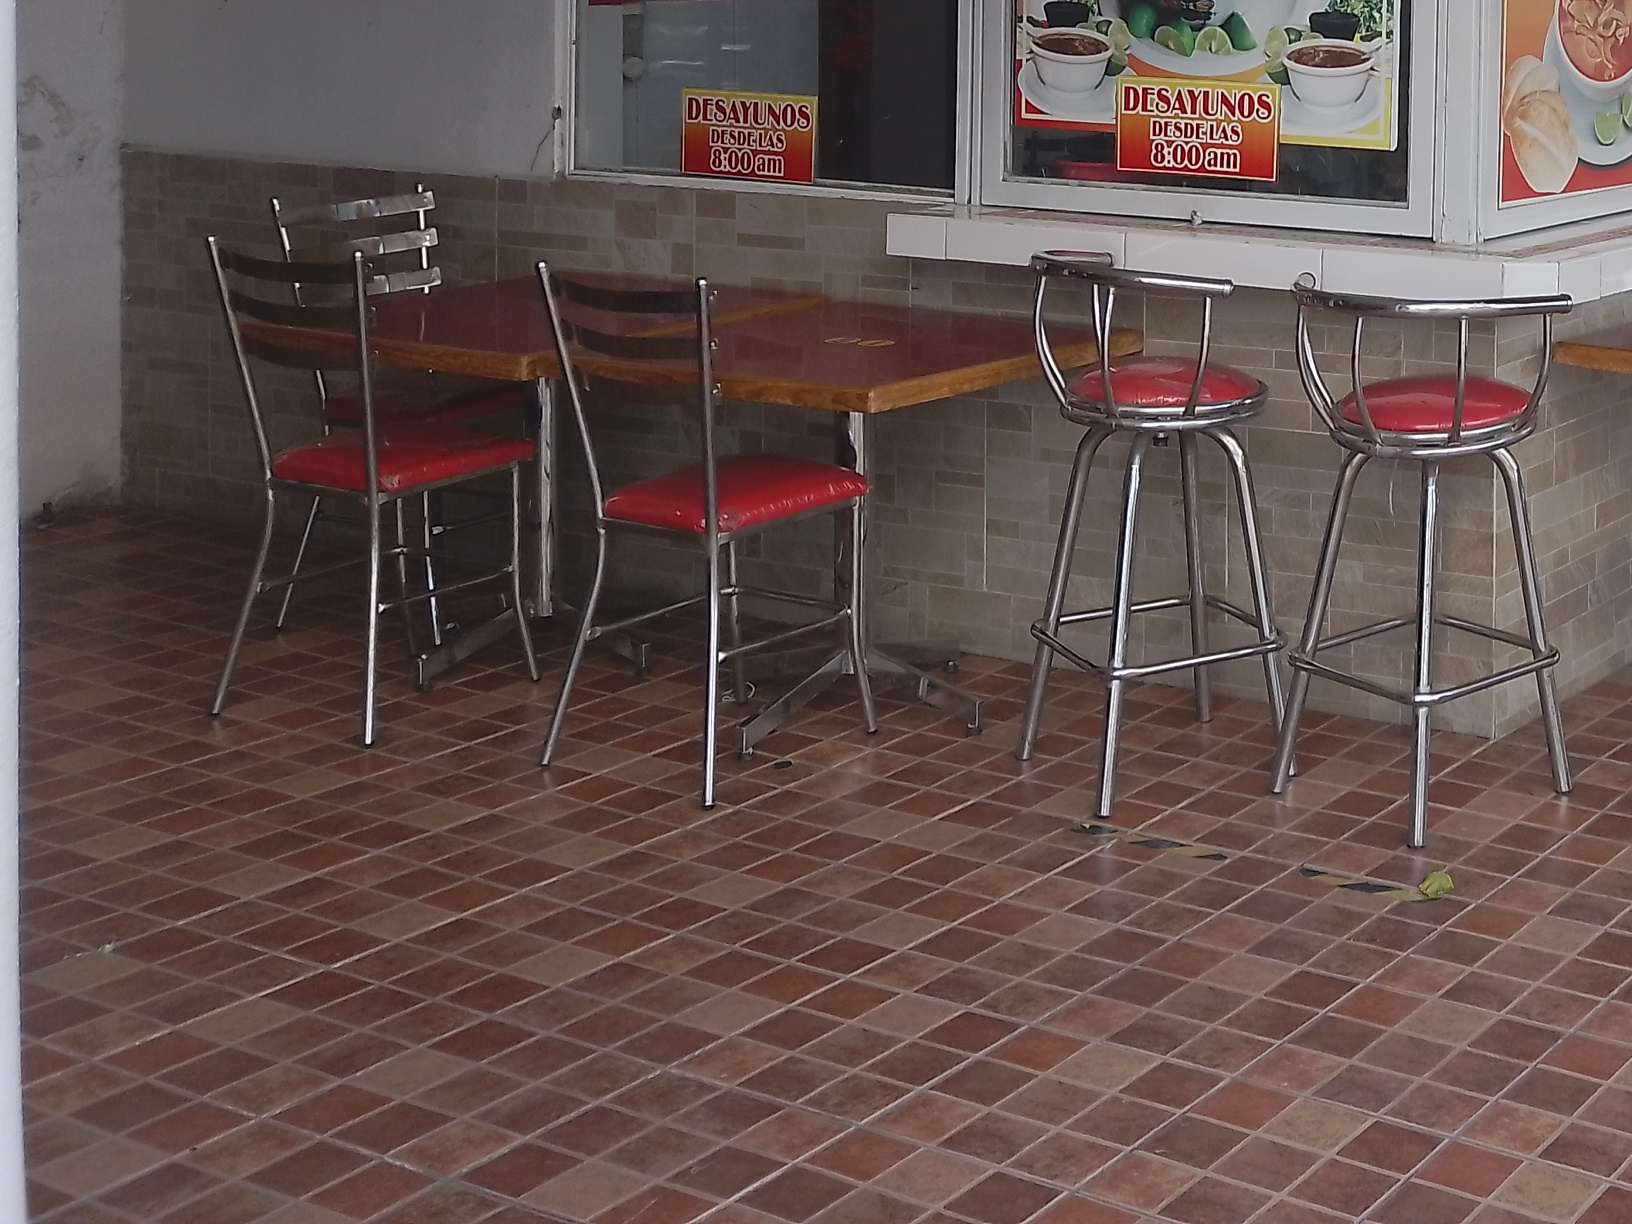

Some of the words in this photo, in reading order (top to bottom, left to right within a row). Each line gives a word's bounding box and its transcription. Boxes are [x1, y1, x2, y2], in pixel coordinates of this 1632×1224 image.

[687, 97, 811, 128] DESAYUNOS
[1123, 85, 1273, 120] DESAYUNOS
[711, 128, 756, 148] DESDE
[758, 131, 785, 150] LAS
[1152, 120, 1206, 140] DESDE
[1208, 122, 1241, 143] LAS
[711, 148, 753, 171] 8:00
[756, 156, 784, 175] am
[1152, 142, 1202, 167] 8:00
[1206, 149, 1239, 170] am
